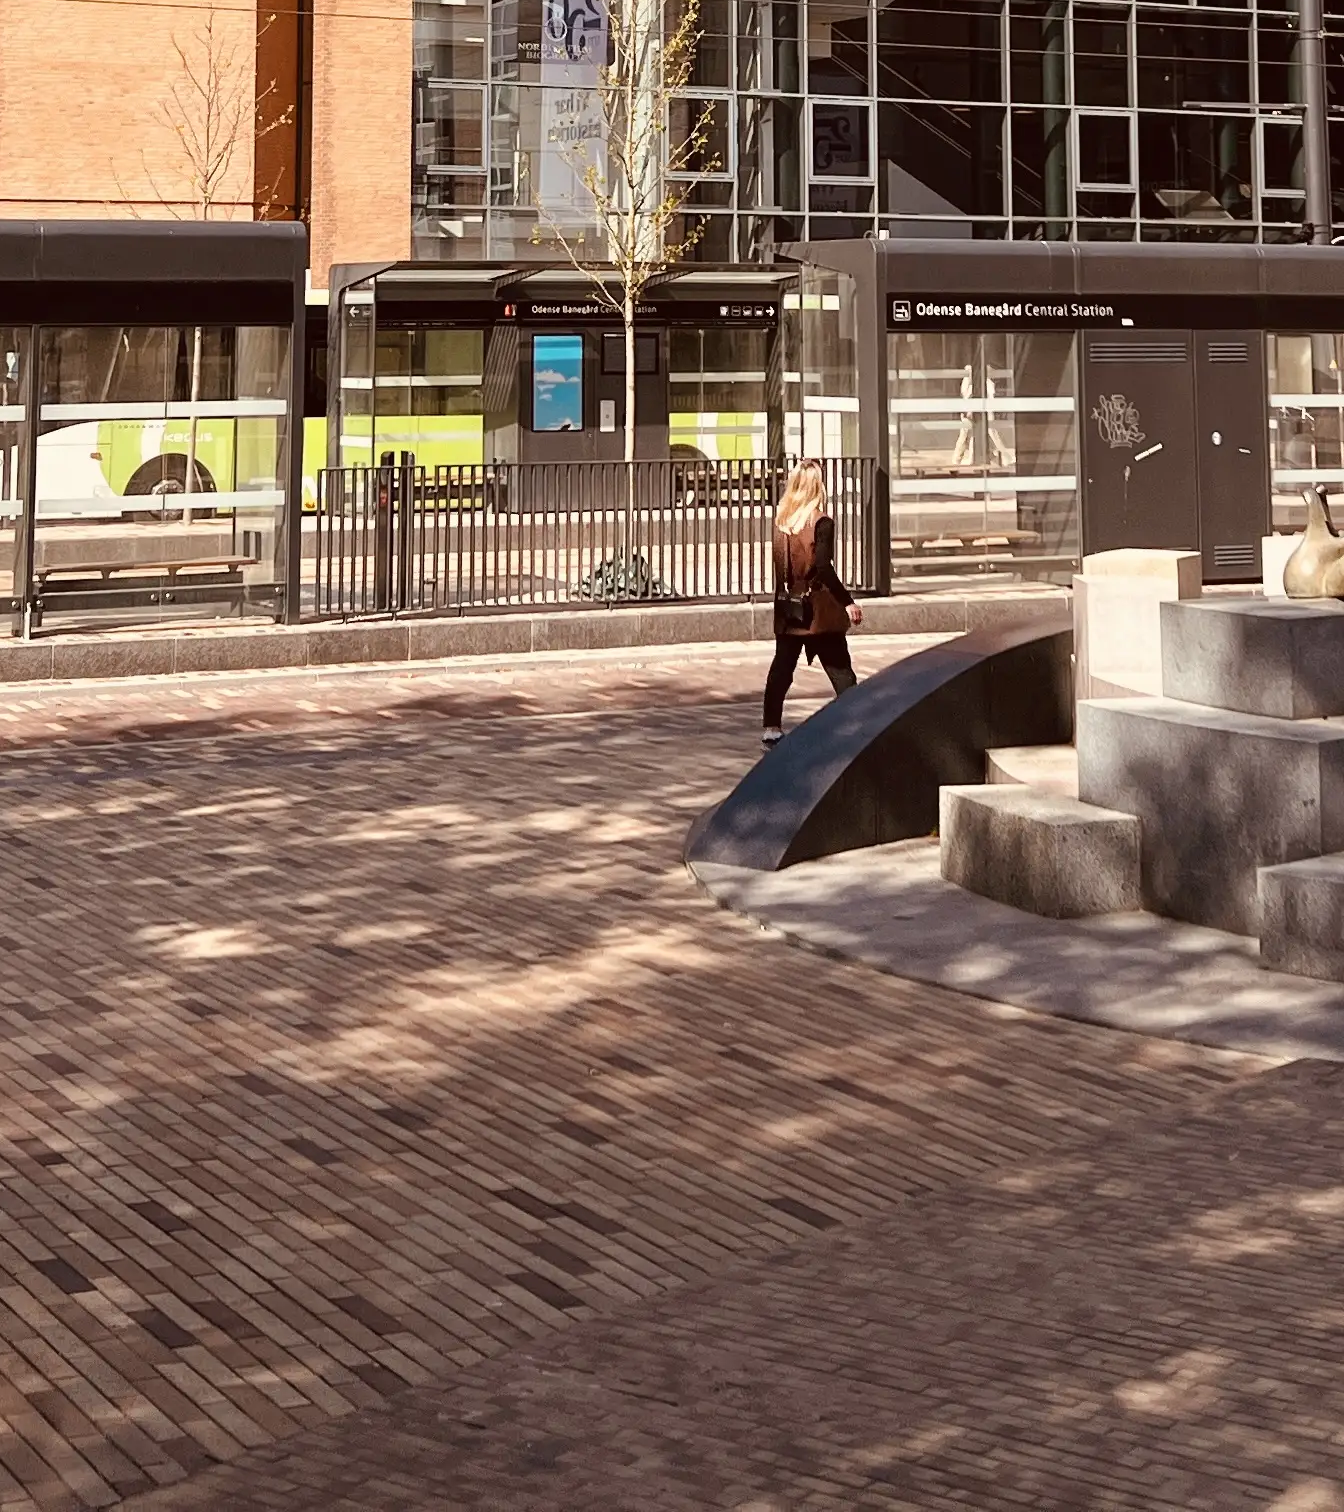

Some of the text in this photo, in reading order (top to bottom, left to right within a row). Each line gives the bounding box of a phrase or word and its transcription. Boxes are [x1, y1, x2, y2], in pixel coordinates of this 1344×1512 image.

[531, 305, 560, 314] Odense
[563, 304, 598, 315] Banegård
[631, 305, 657, 314] tation
[916, 302, 1114, 319] Odense Banegård Central Station
